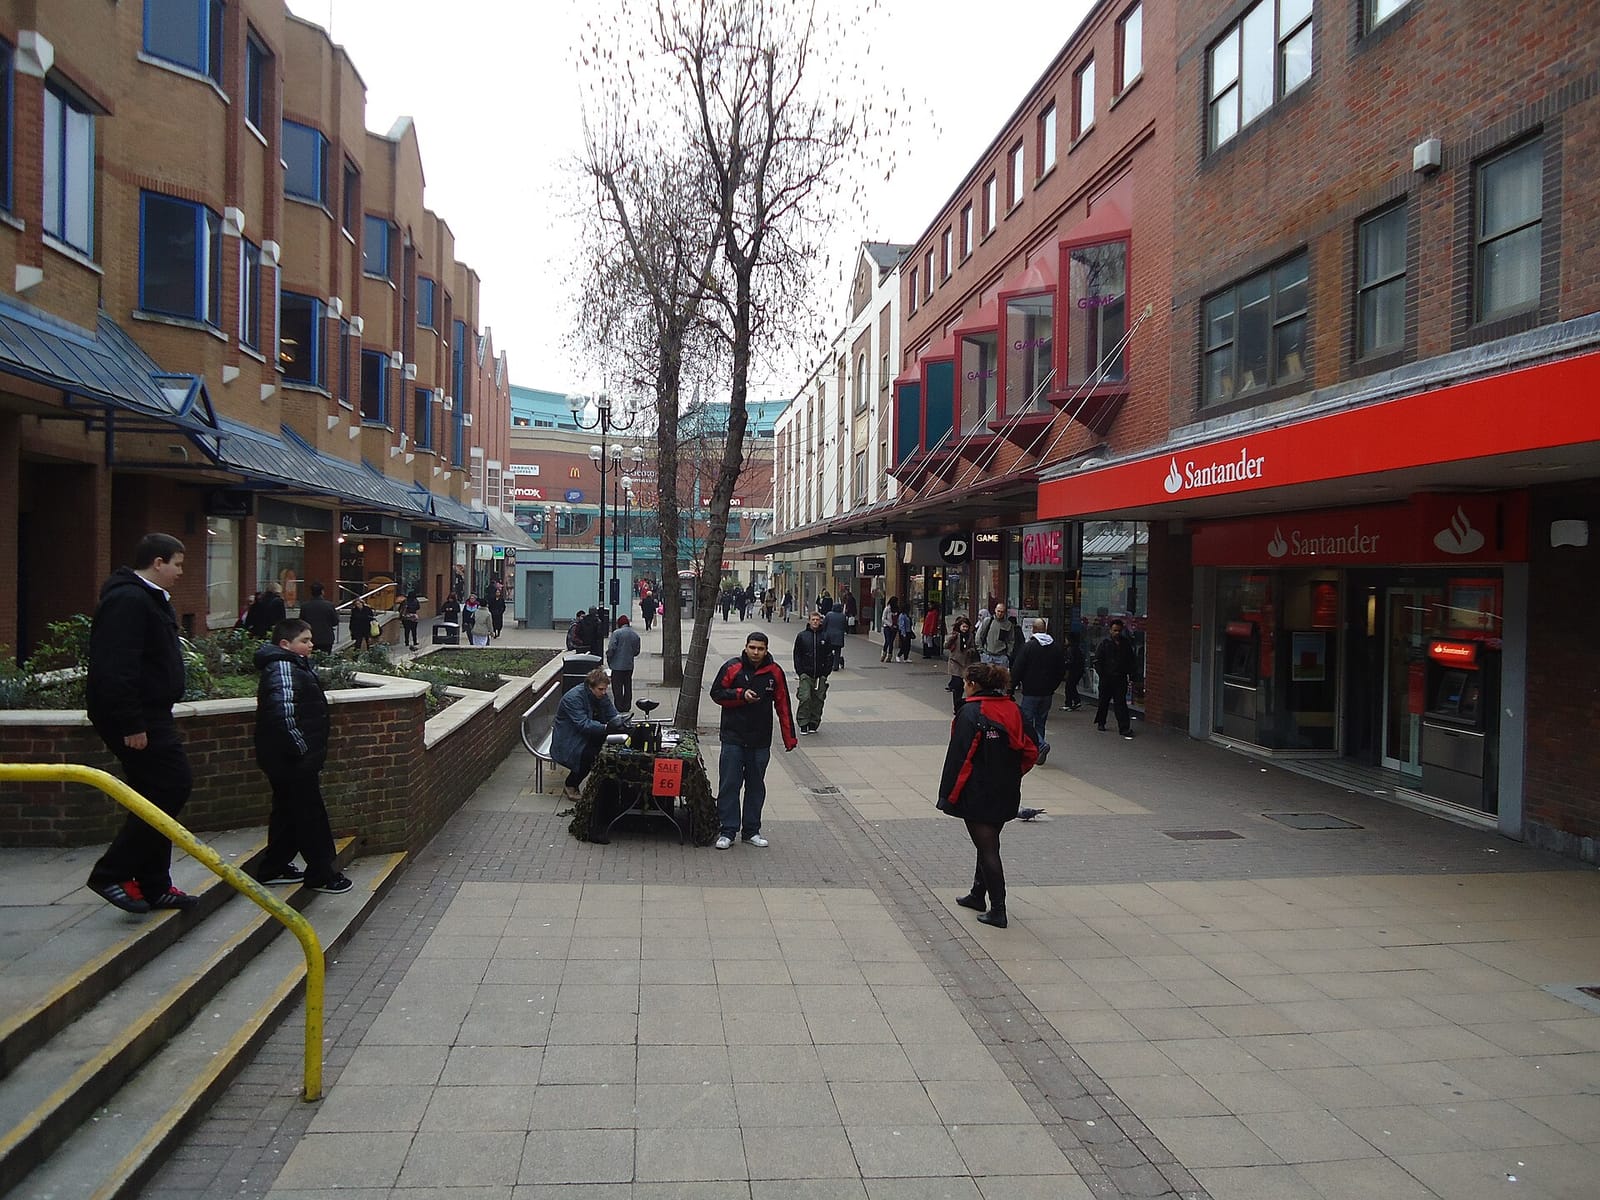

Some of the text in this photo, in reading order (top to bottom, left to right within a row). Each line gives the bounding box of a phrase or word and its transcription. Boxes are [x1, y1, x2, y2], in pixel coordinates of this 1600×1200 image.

[1184, 447, 1265, 489] Santander
[976, 534, 999, 543] GAME
[1290, 523, 1380, 556] Santander
[944, 540, 968, 556] JD
[1023, 530, 1063, 566] GAME
[657, 763, 678, 772] SALE
[660, 779, 674, 788] £6
